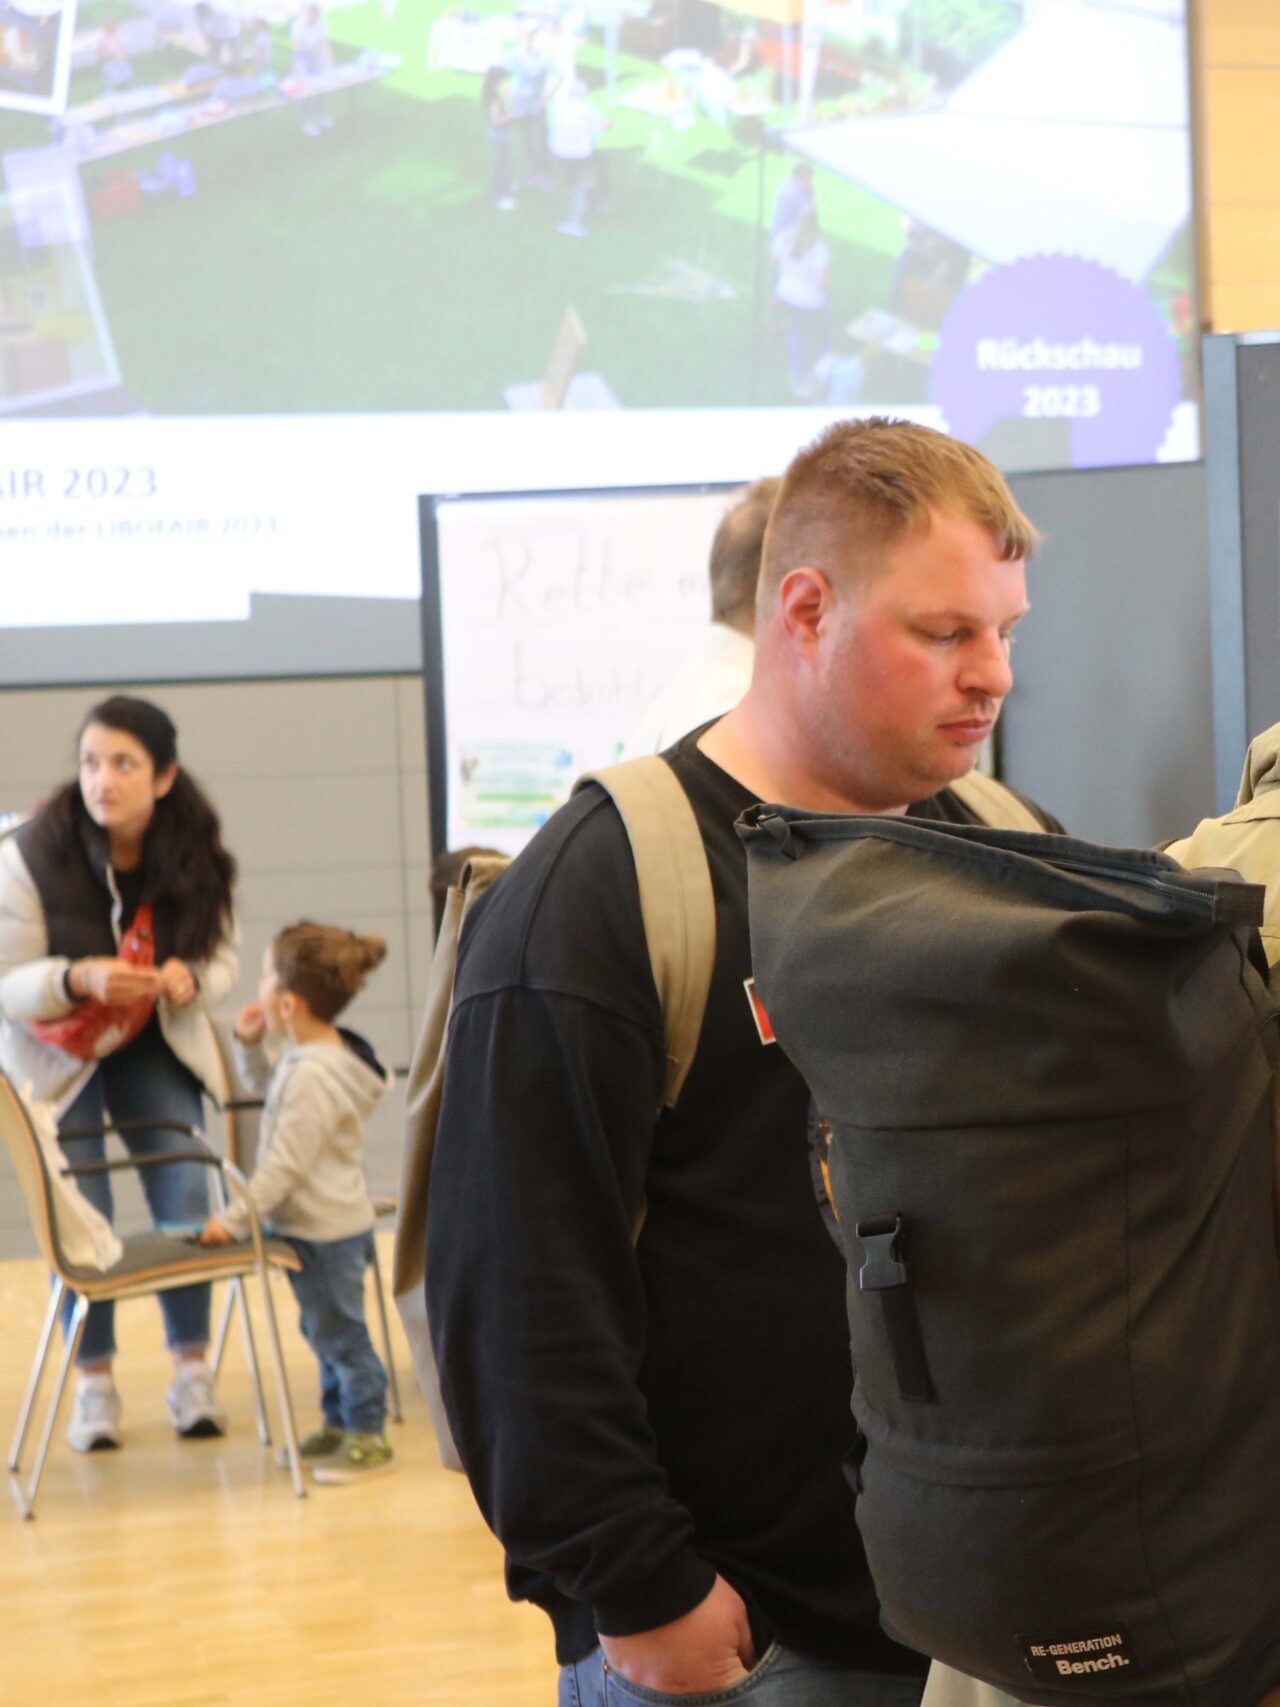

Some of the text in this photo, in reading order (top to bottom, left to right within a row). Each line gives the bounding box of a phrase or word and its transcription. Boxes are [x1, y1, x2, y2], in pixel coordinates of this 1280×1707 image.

[976, 335, 1143, 371] Rückschau
[1022, 383, 1101, 418] 2023
[63, 466, 158, 499] 2023
[1030, 1633, 1123, 1657] RE-GENERATION
[1055, 1652, 1130, 1676] Bench.
